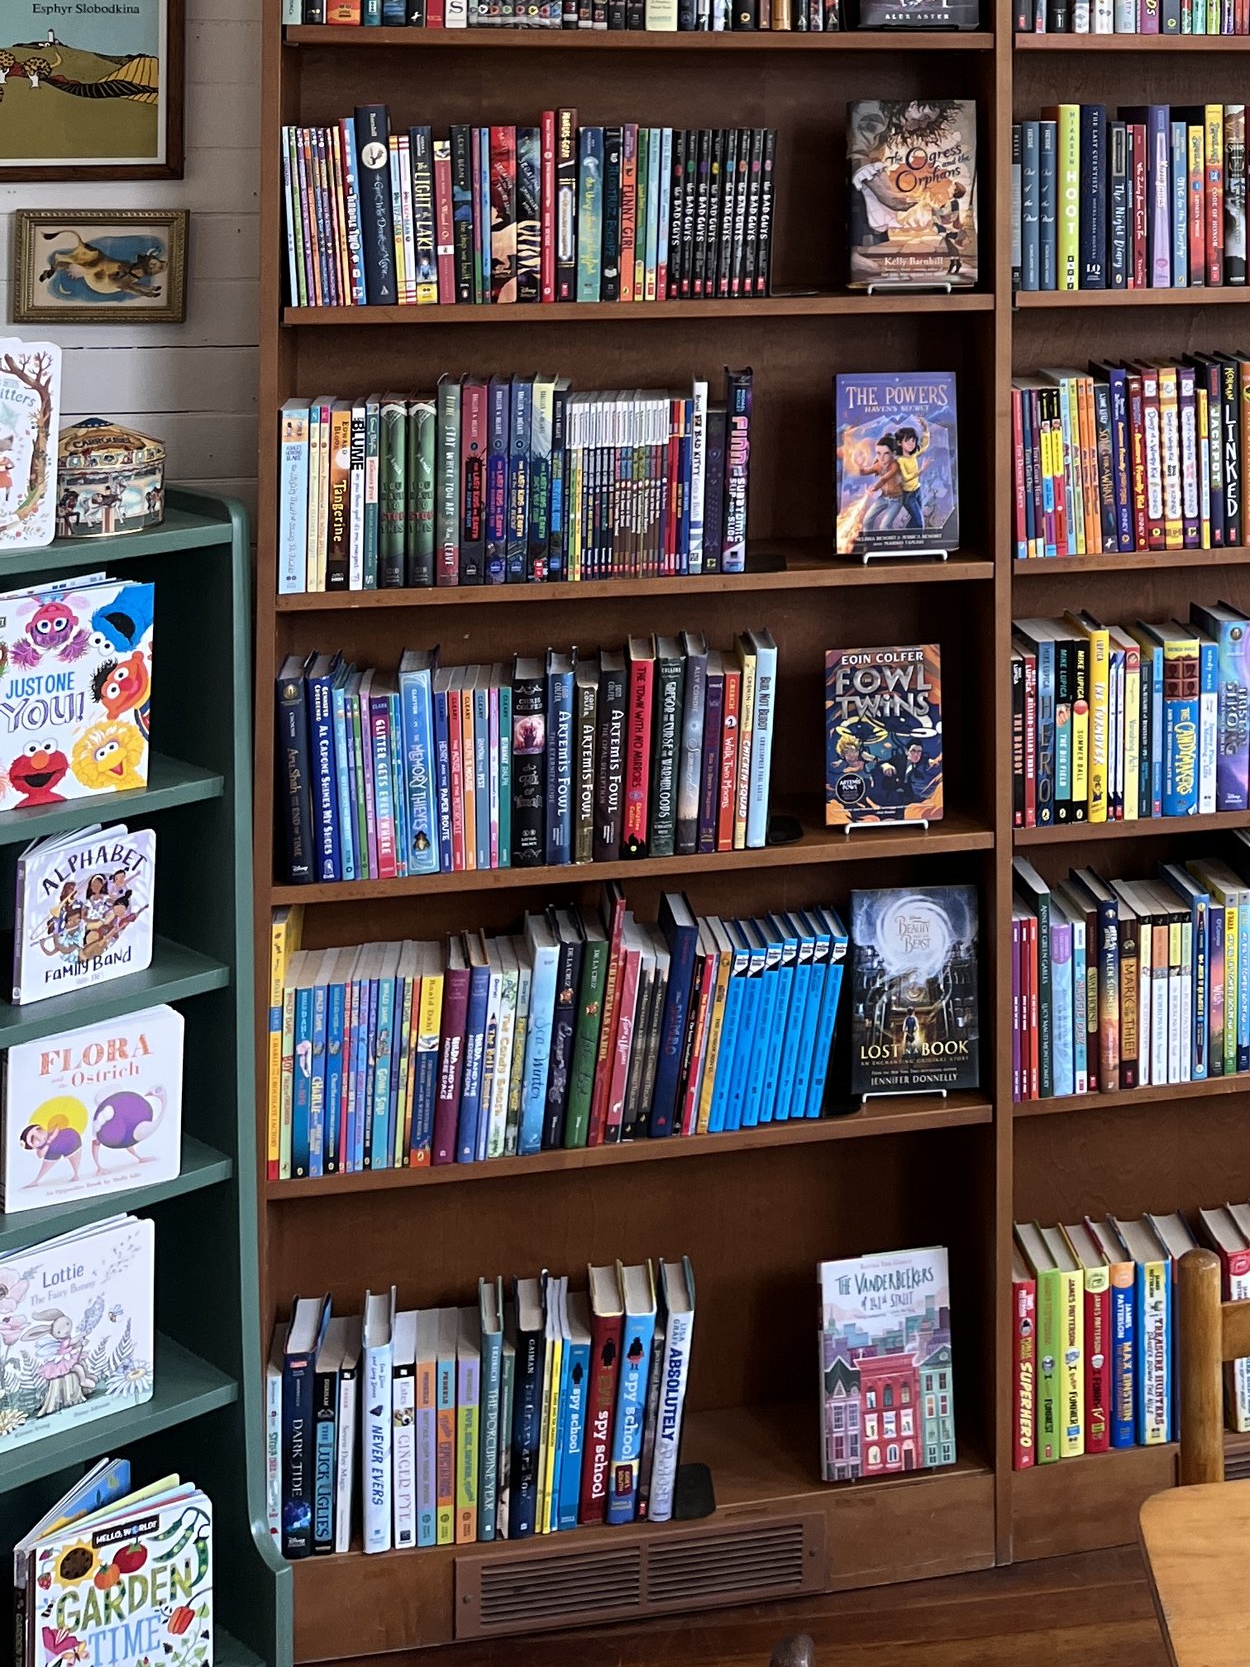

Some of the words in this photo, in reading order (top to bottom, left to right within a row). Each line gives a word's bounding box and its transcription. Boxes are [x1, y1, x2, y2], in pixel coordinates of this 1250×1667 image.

[33, 4, 72, 15] Esphyr
[75, 3, 140, 14] Slobodkina
[885, 152, 903, 167] The
[904, 143, 963, 171] Ogress
[941, 158, 958, 169] and
[959, 153, 972, 165] the
[894, 166, 962, 193] Orphans
[1066, 170, 1078, 235] HOOT
[884, 256, 906, 268] Kelly
[909, 256, 944, 266] Barnhill
[845, 386, 881, 408] THE
[885, 384, 949, 406] POWERS
[1224, 367, 1234, 401] KORMAN
[864, 405, 899, 414] HAVEN'S
[902, 405, 930, 413] SECRET
[350, 420, 365, 471] BLUME
[1210, 408, 1221, 484] JACKPOT
[1225, 404, 1238, 518] LINKED
[841, 653, 872, 665] EOIN
[875, 651, 924, 664] COLFER
[5, 677, 43, 699] JUST
[45, 671, 75, 694] ONE
[835, 663, 932, 695] FOWL
[0, 692, 84, 733] YOU!
[611, 709, 625, 768] ARTEMIS
[608, 772, 622, 814] FOWL
[42, 843, 148, 896] ALPHABET
[894, 915, 930, 936] BEAUTY
[904, 934, 931, 954] BEAST
[39, 1033, 154, 1077] FLORA
[860, 1044, 900, 1061] LOST
[921, 1039, 969, 1057] BOOK
[71, 1062, 141, 1087] Ostrich
[870, 1075, 910, 1086] JENNIFER
[913, 1073, 958, 1084] DONNELLY
[31, 1294, 46, 1306] The
[49, 1289, 67, 1301] Fairy
[71, 1280, 96, 1294] Bunny
[43, 1264, 84, 1288] Lottie
[835, 1275, 851, 1296] THE
[854, 1266, 935, 1295] VANDERBEEKERS
[626, 1372, 639, 1408] spy
[661, 1347, 682, 1442] ABSOLUTELY
[1019, 1361, 1032, 1448] SUPERHERO
[292, 1419, 304, 1458] DARK
[596, 1409, 609, 1443] spy
[622, 1412, 638, 1461] school
[371, 1425, 383, 1464] NEVER
[291, 1463, 303, 1497] TIDE
[370, 1469, 384, 1506] EVERS
[592, 1447, 608, 1499] school
[95, 1531, 123, 1545] HELLO,
[55, 1558, 192, 1634] GARDEN
[89, 1614, 161, 1667] TIME
